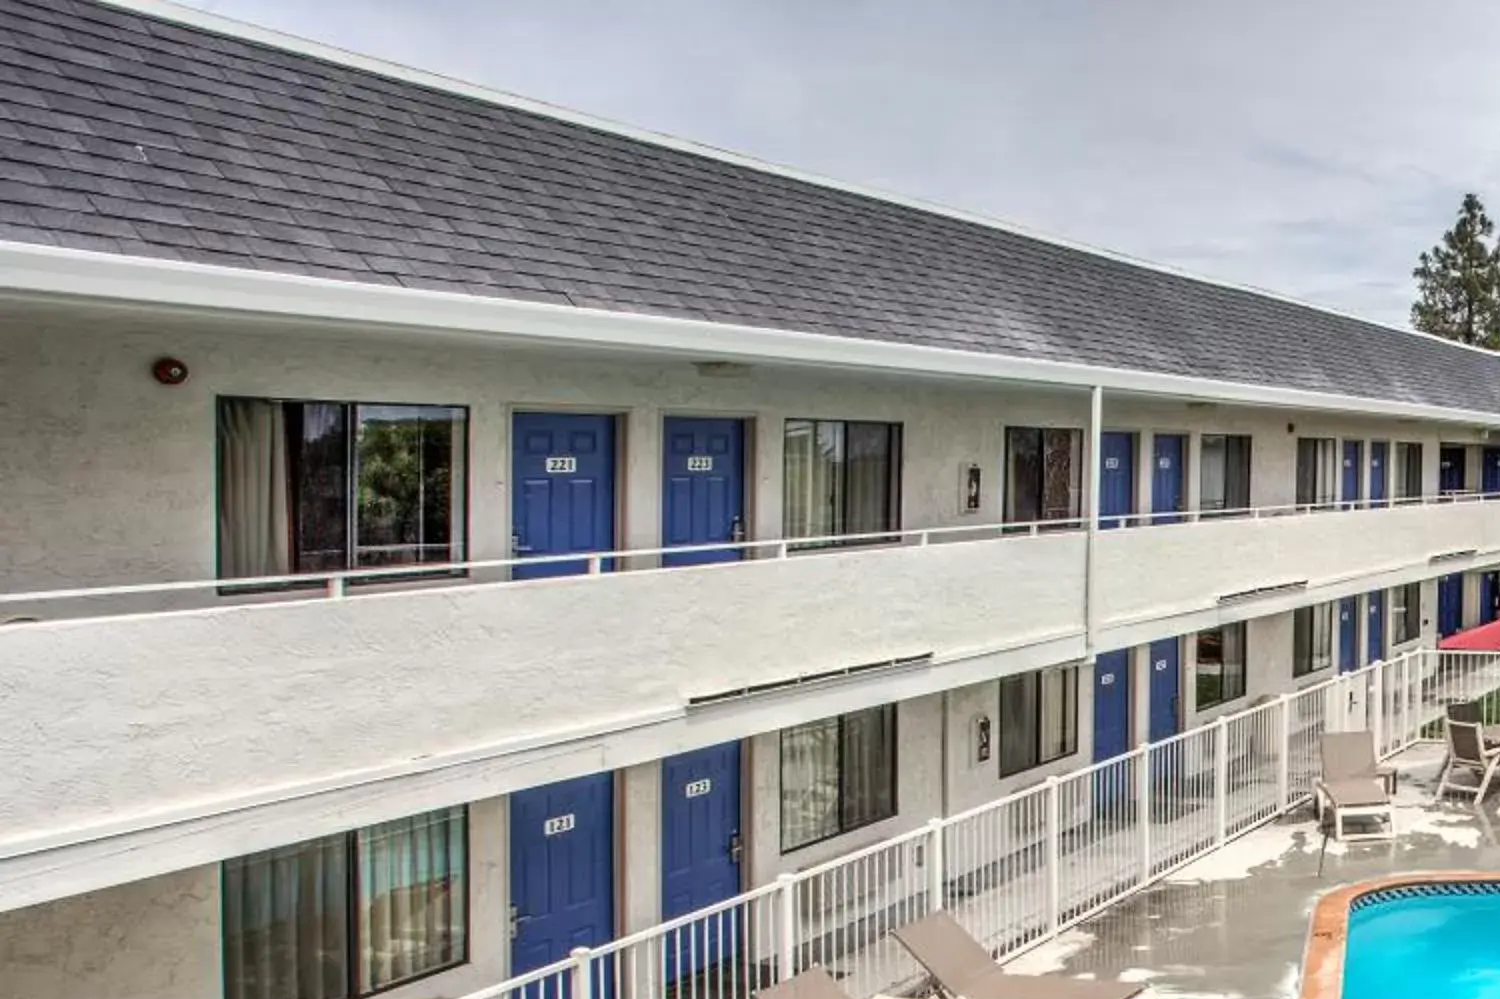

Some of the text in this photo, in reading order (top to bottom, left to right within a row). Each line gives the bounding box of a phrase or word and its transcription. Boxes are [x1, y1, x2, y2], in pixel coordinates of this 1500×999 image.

[550, 458, 573, 471] 221
[689, 781, 706, 795] 123
[548, 817, 571, 832] 121
